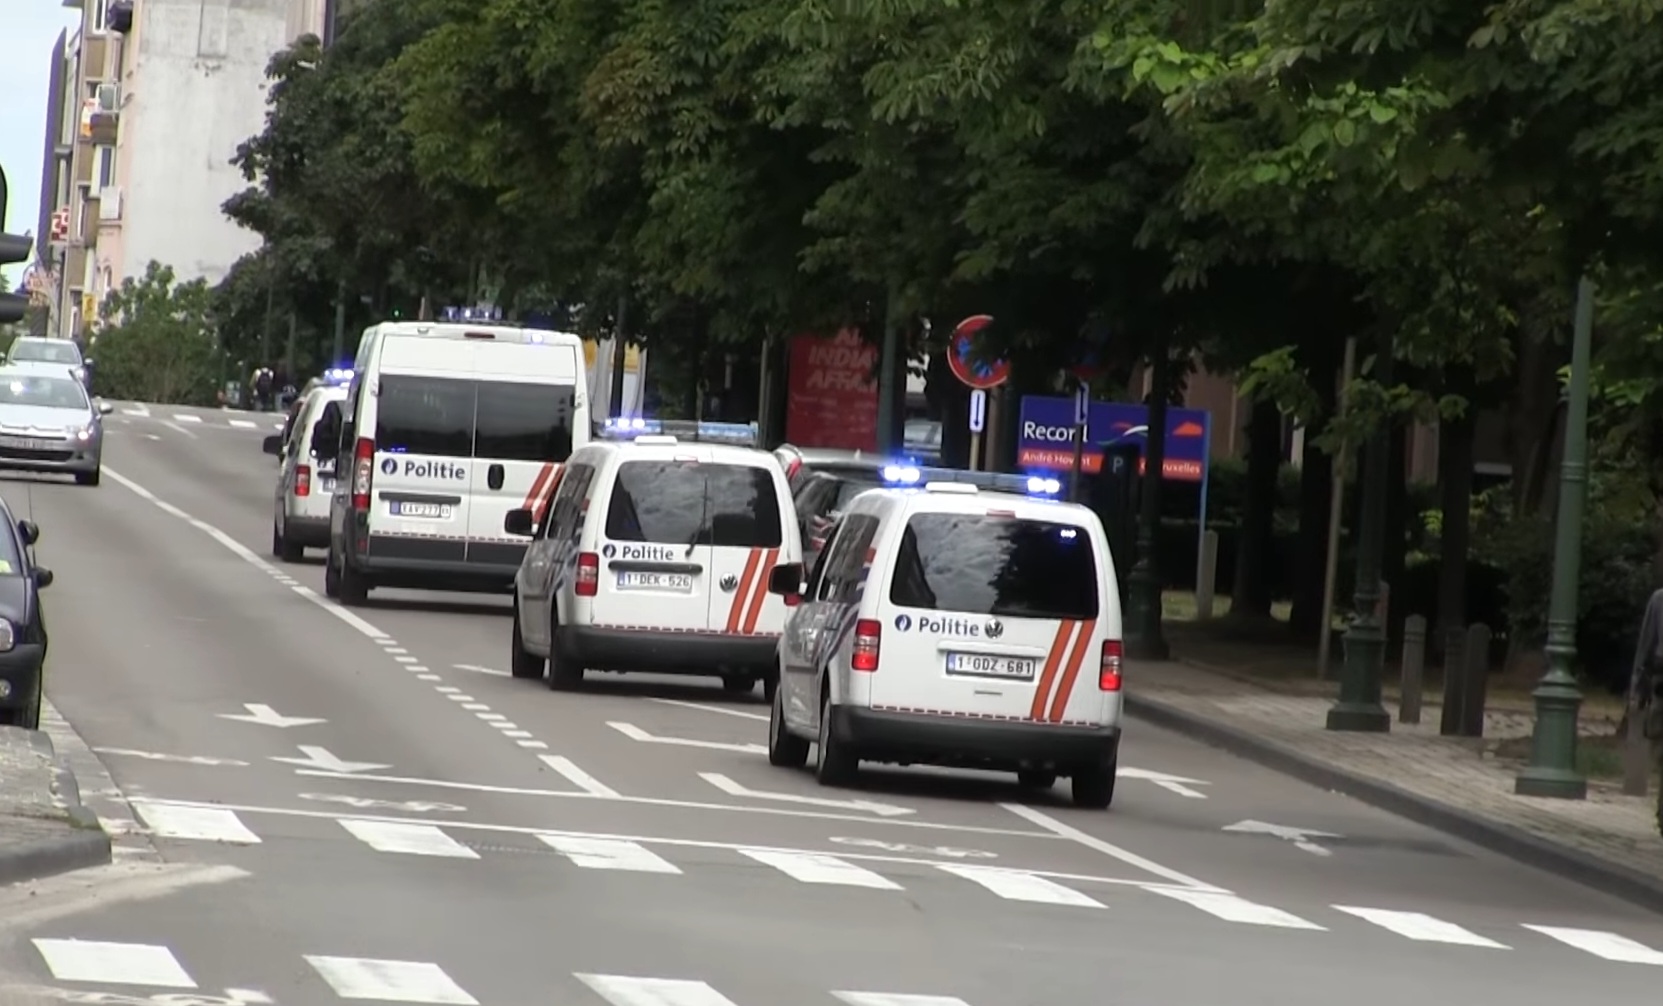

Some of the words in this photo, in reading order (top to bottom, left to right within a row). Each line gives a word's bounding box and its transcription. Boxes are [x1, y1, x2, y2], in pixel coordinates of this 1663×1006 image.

[1023, 421, 1088, 442] Recor
[404, 461, 465, 480] Politie
[622, 545, 674, 561] Politie
[919, 616, 979, 636] Politie
